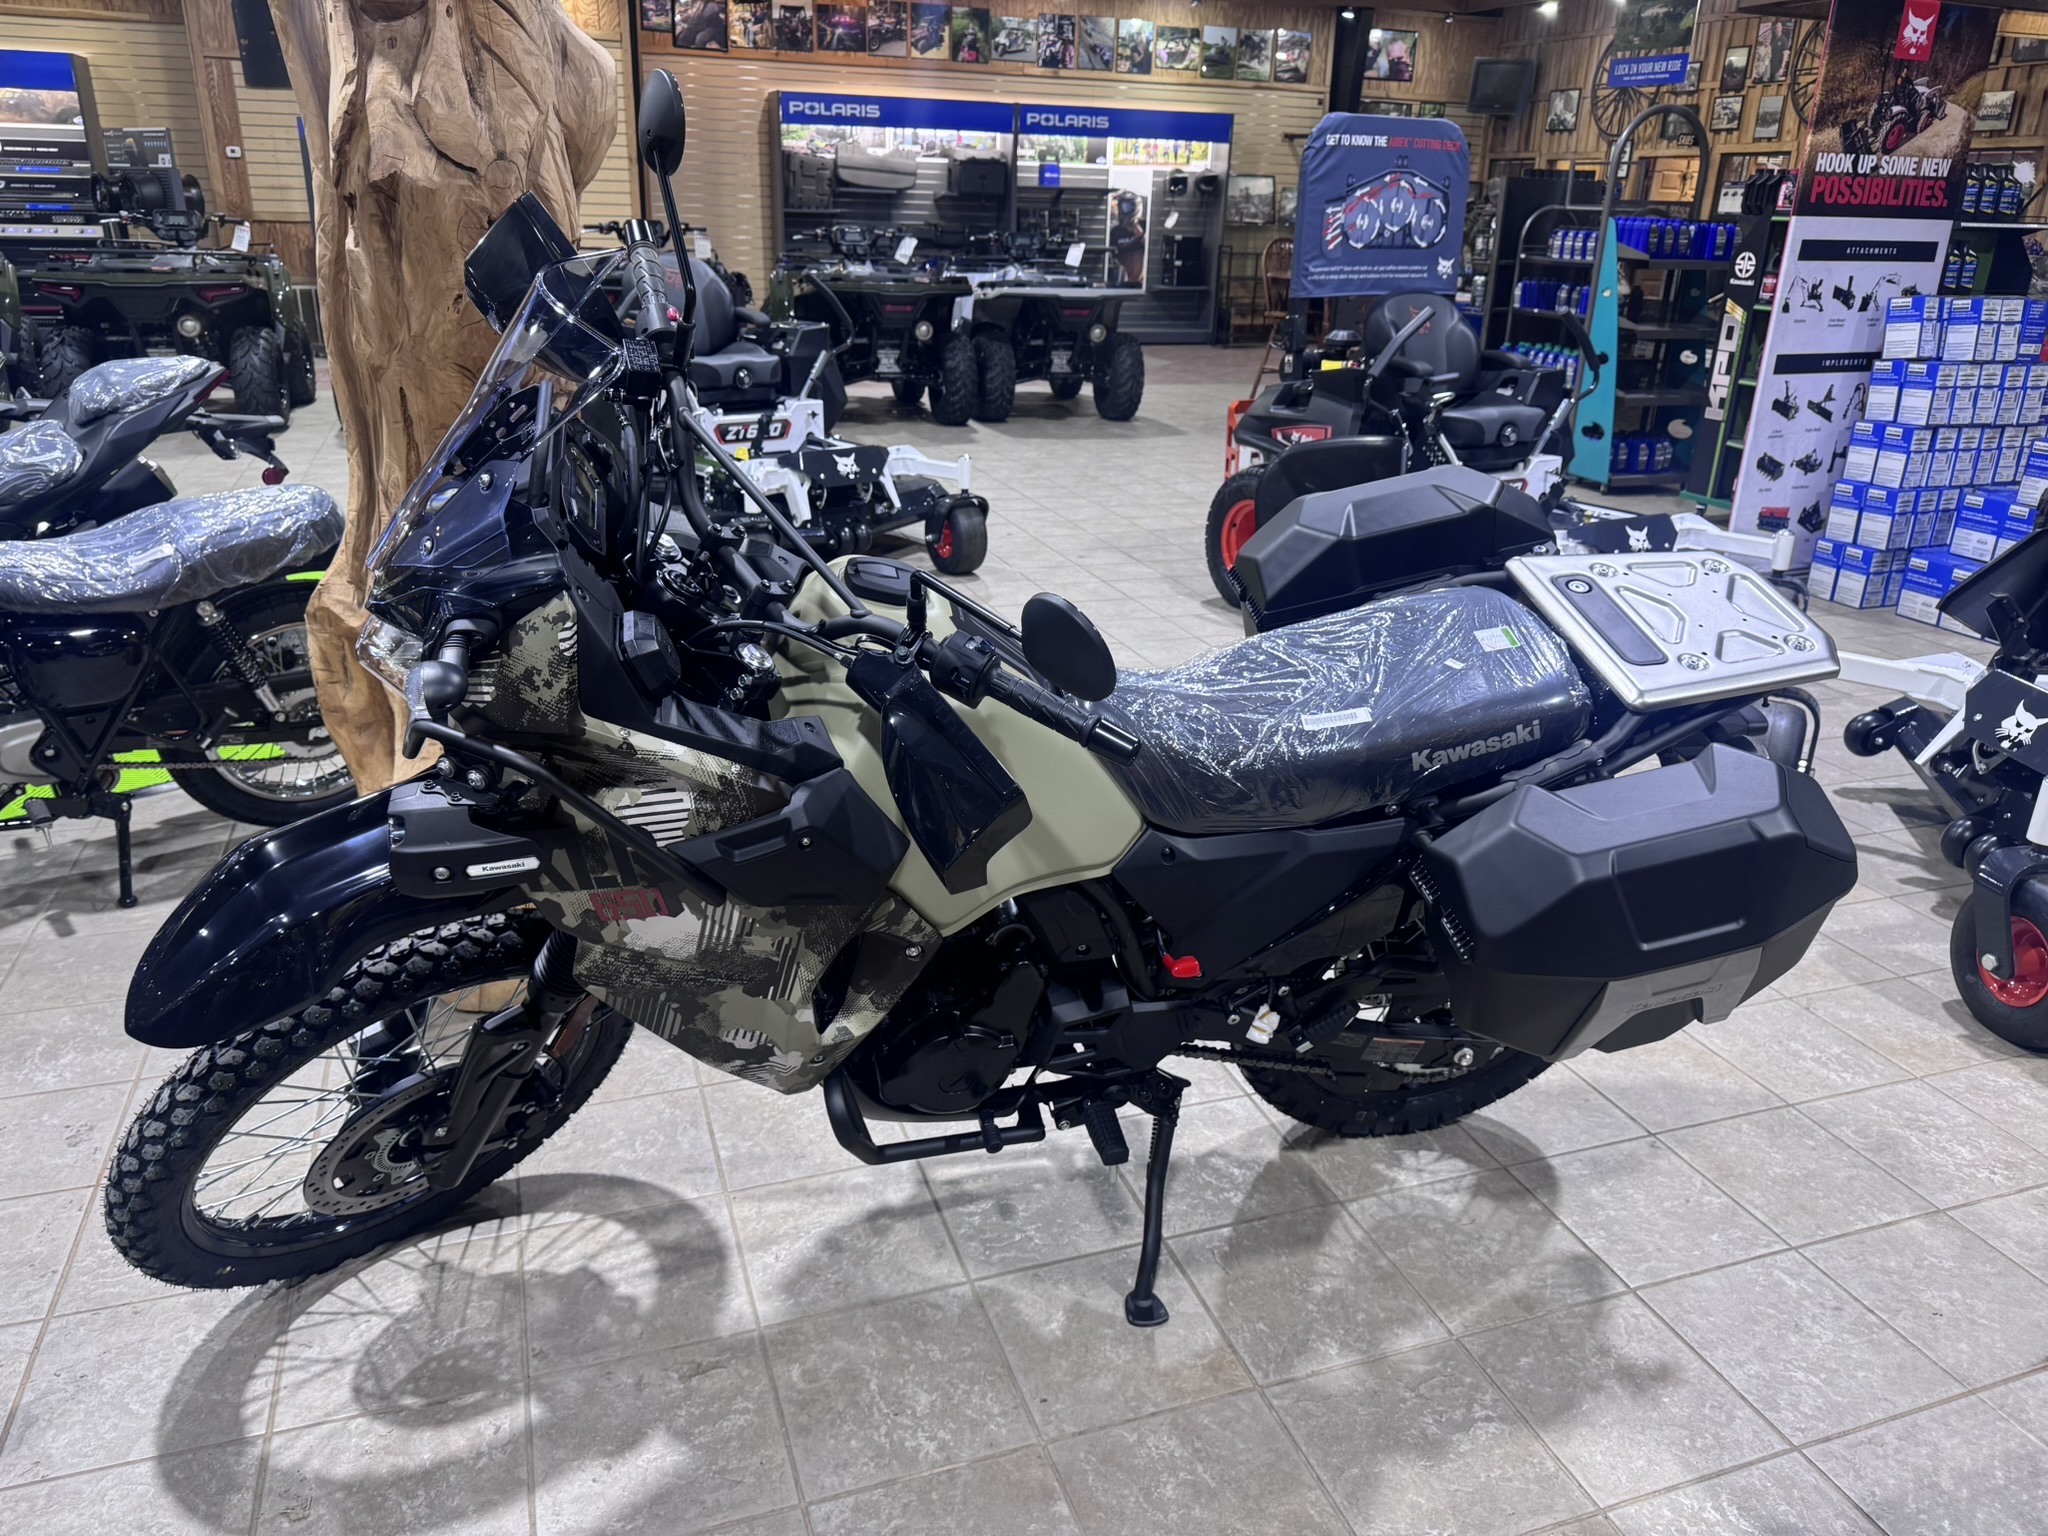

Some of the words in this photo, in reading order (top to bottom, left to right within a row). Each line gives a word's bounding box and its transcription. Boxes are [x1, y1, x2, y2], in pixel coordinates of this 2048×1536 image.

[1614, 64, 1629, 76] LOCK
[1629, 63, 1638, 75] IN
[1638, 62, 1653, 74] YOUR
[1653, 60, 1667, 73] NEW
[1667, 60, 1683, 71] RIDE
[788, 100, 881, 119] POLARIS
[1026, 111, 1110, 129] POLARIS
[1325, 133, 1339, 146] GET
[1340, 134, 1350, 146] TO
[1350, 134, 1373, 147] KNOW
[1374, 135, 1388, 147] THE
[1815, 152, 1856, 173] HOOK
[1856, 154, 1877, 174] UP
[1879, 155, 1919, 176] SOME
[1920, 157, 1952, 177] NEW
[1809, 175, 1949, 208] POSSIBILITIES.
[1846, 246, 1898, 255] ATTACHMENTS
[1821, 358, 1867, 368] IMPLEMENTS
[1411, 719, 1541, 772] Kawasaki
[482, 861, 525, 872] Kawasaki
[589, 886, 670, 923] 650
